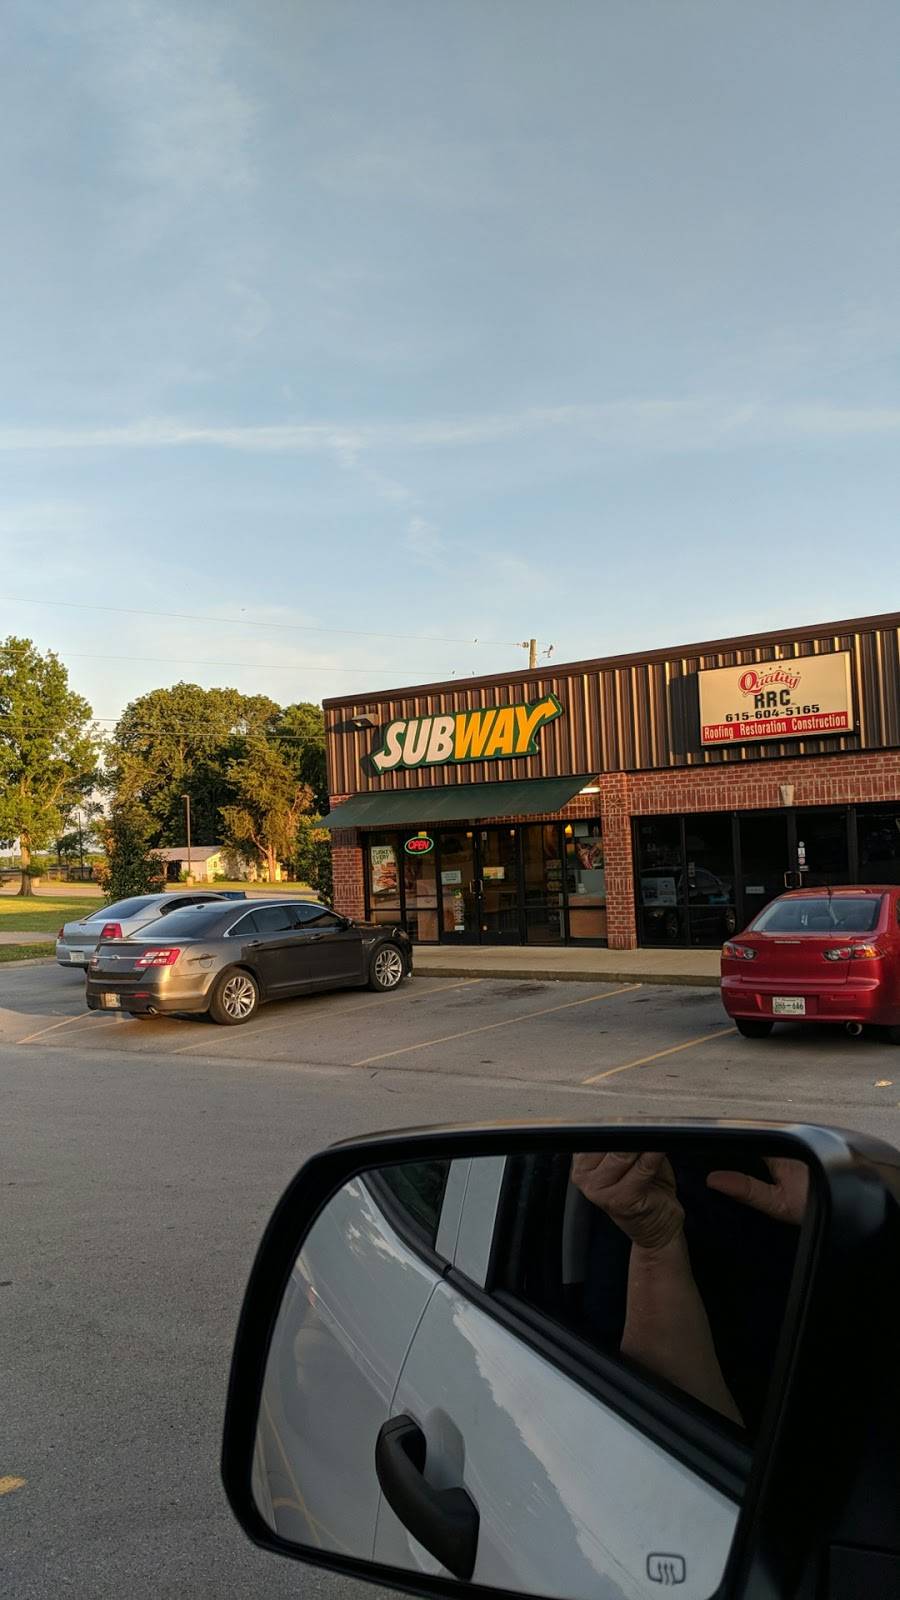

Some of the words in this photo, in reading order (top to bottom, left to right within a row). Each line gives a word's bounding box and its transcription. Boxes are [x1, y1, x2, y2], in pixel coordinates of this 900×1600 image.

[738, 669, 802, 697] Quality
[754, 689, 792, 709] RRC
[725, 704, 820, 722] 615-604-5165
[373, 697, 558, 771] SUBWAY
[704, 726, 734, 739] Roofing
[740, 720, 787, 736] Restoration
[791, 714, 846, 731] Construction
[407, 839, 430, 851] OPEN
